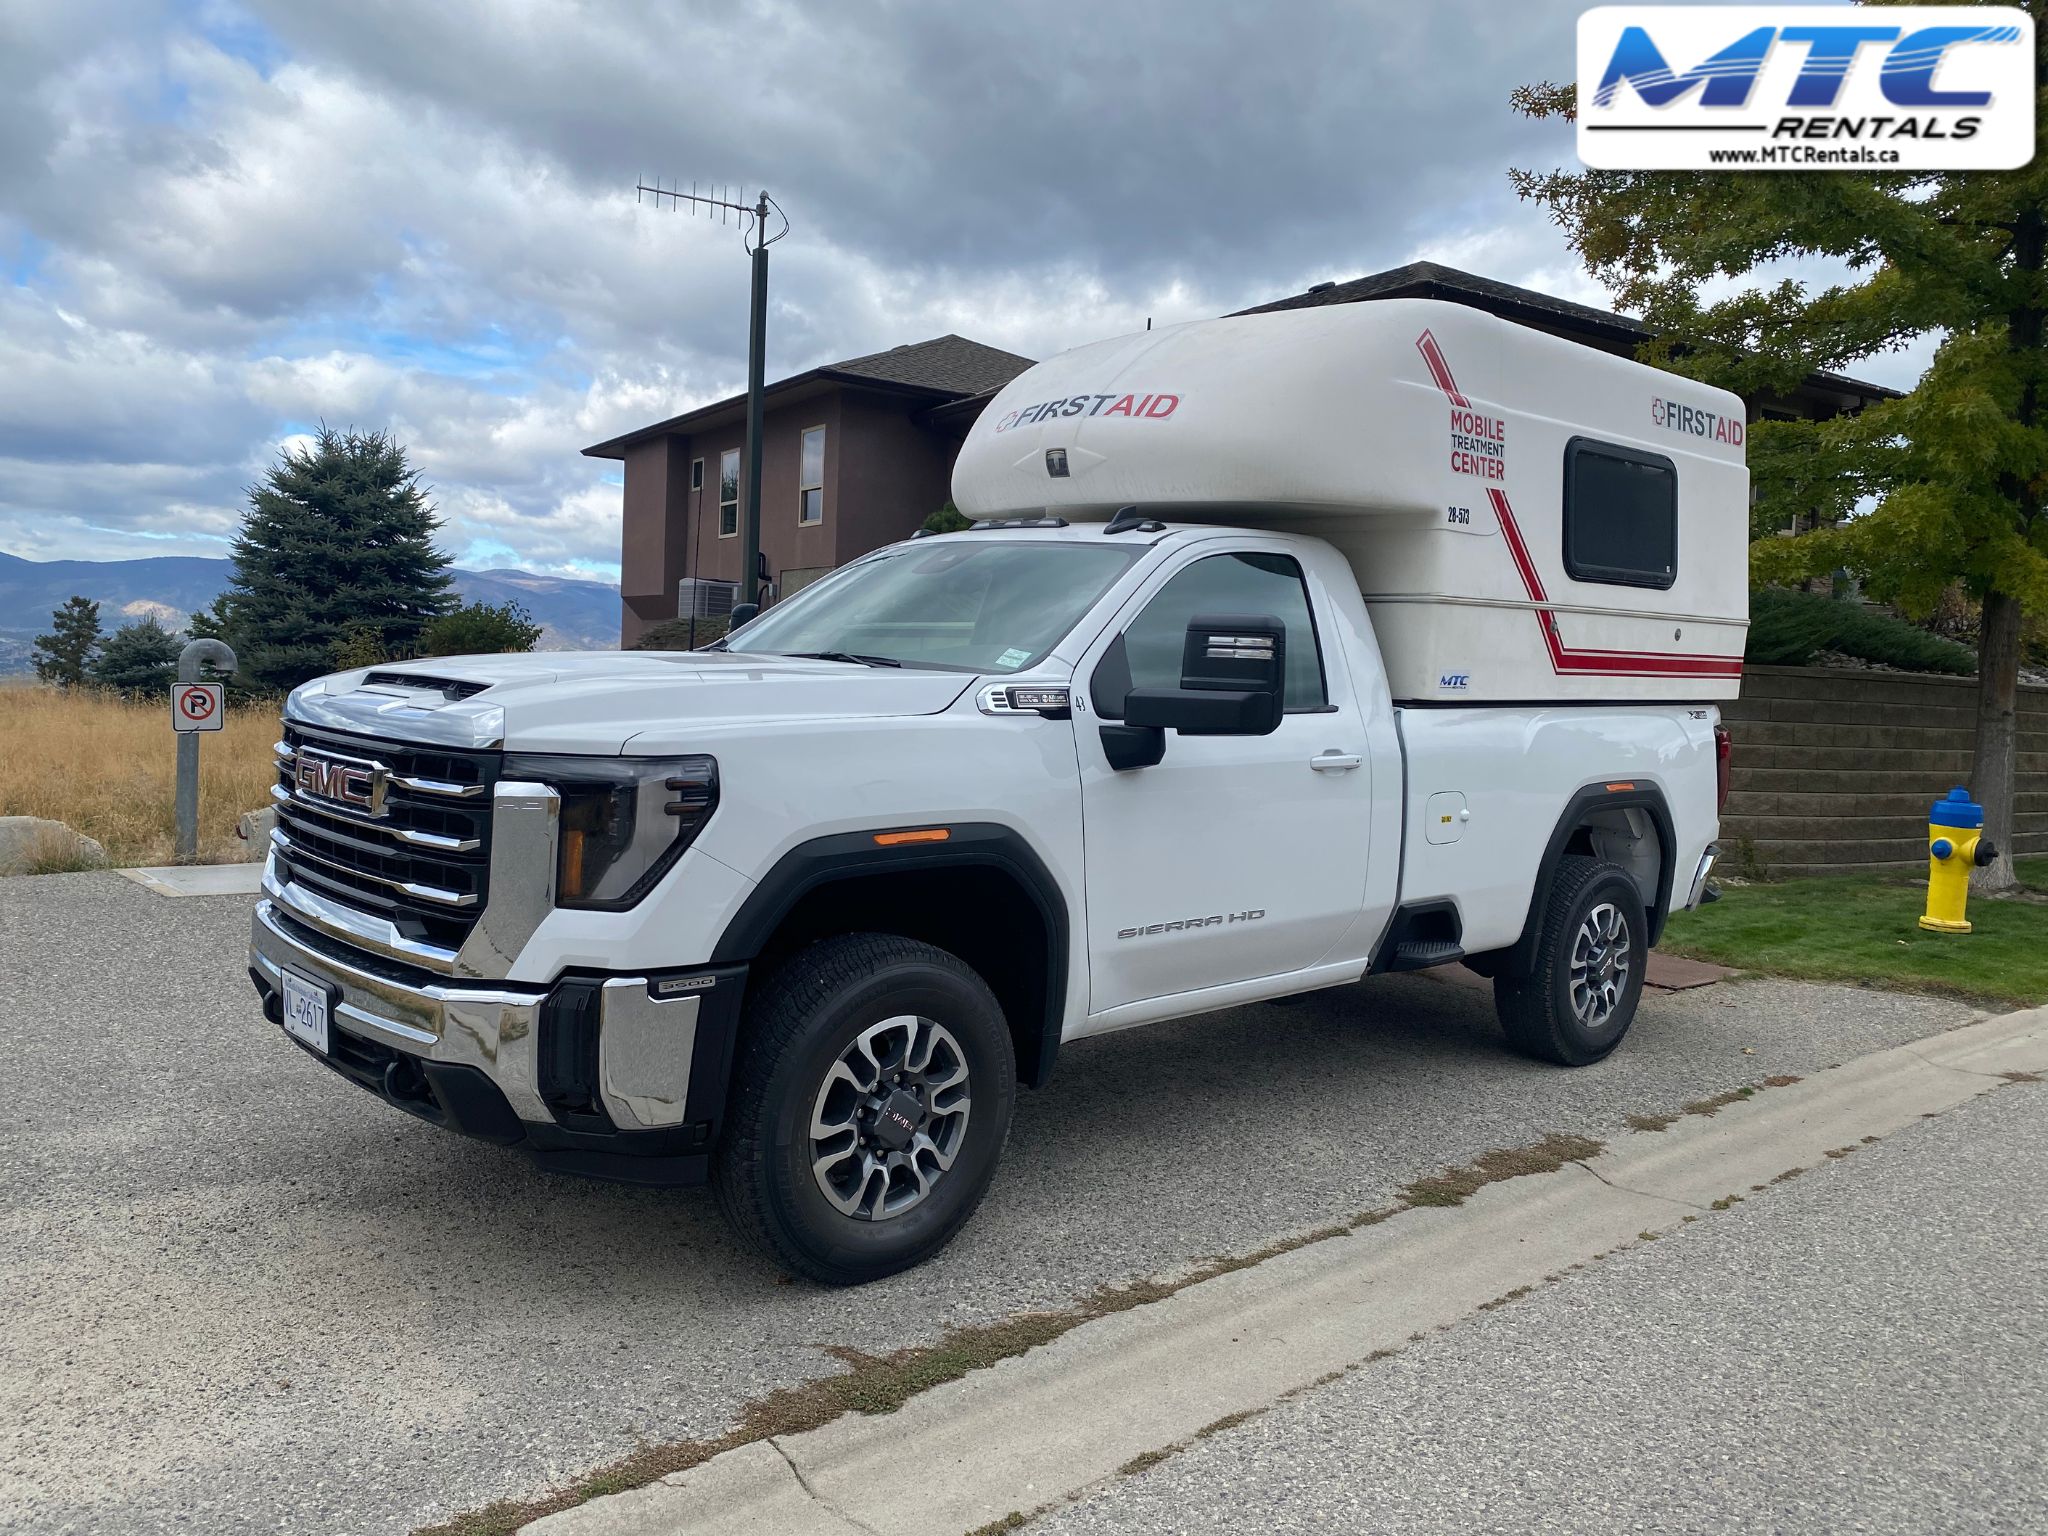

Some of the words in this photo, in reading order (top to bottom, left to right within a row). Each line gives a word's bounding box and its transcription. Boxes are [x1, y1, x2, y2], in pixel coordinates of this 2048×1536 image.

[1451, 410, 1505, 442] MOBILE
[1451, 433, 1505, 458] TREATMENT
[1451, 451, 1505, 480] CENTER
[1447, 506, 1470, 524] 28-573
[1440, 675, 1470, 686] MTC
[296, 757, 374, 808] GMC
[1117, 915, 1223, 939] SIERRA
[1228, 909, 1265, 923] HD
